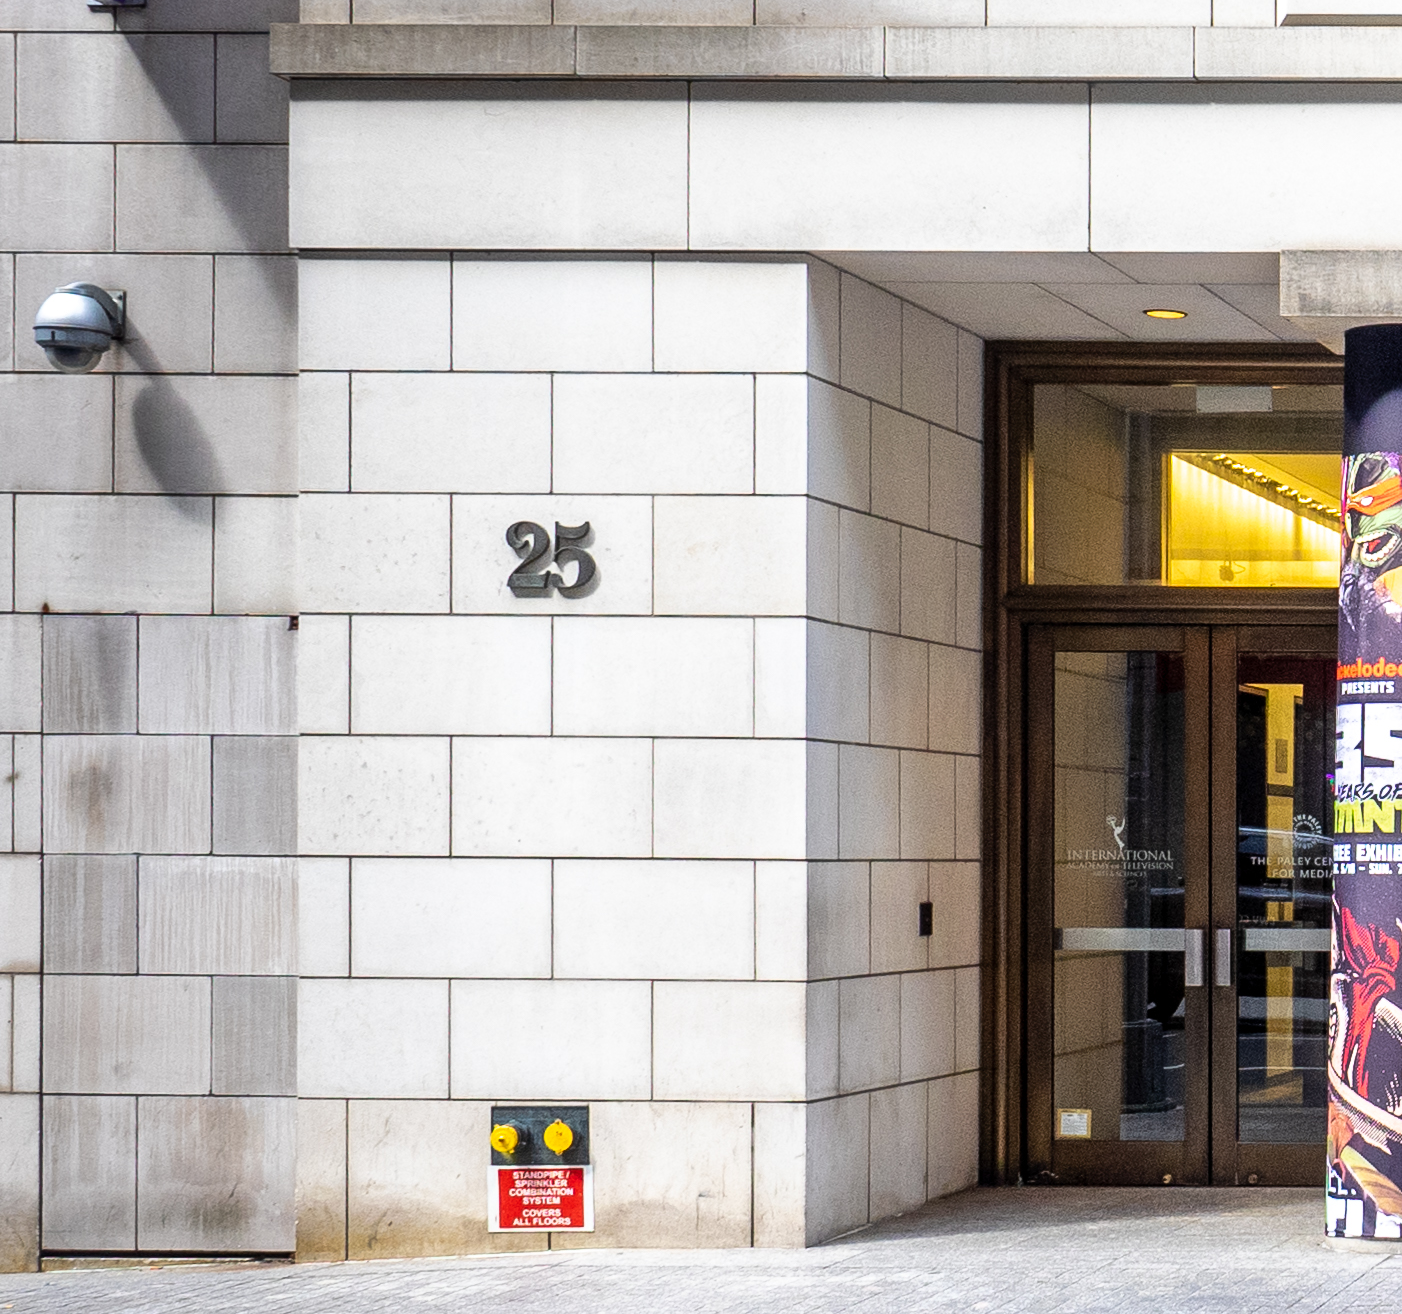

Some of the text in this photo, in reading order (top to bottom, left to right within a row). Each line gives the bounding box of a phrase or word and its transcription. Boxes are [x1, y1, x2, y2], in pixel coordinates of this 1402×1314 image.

[506, 521, 598, 598] 25
[1341, 681, 1395, 696] PRESENTS
[1067, 850, 1174, 861] INTERNATIONAL
[1250, 856, 1272, 866] THE
[1278, 856, 1311, 866] PALEY
[1272, 869, 1295, 878] FOR
[513, 1171, 564, 1179] STANDPIPE
[515, 1179, 567, 1187] SPRINKLER
[509, 1188, 574, 1196] COMBINATION
